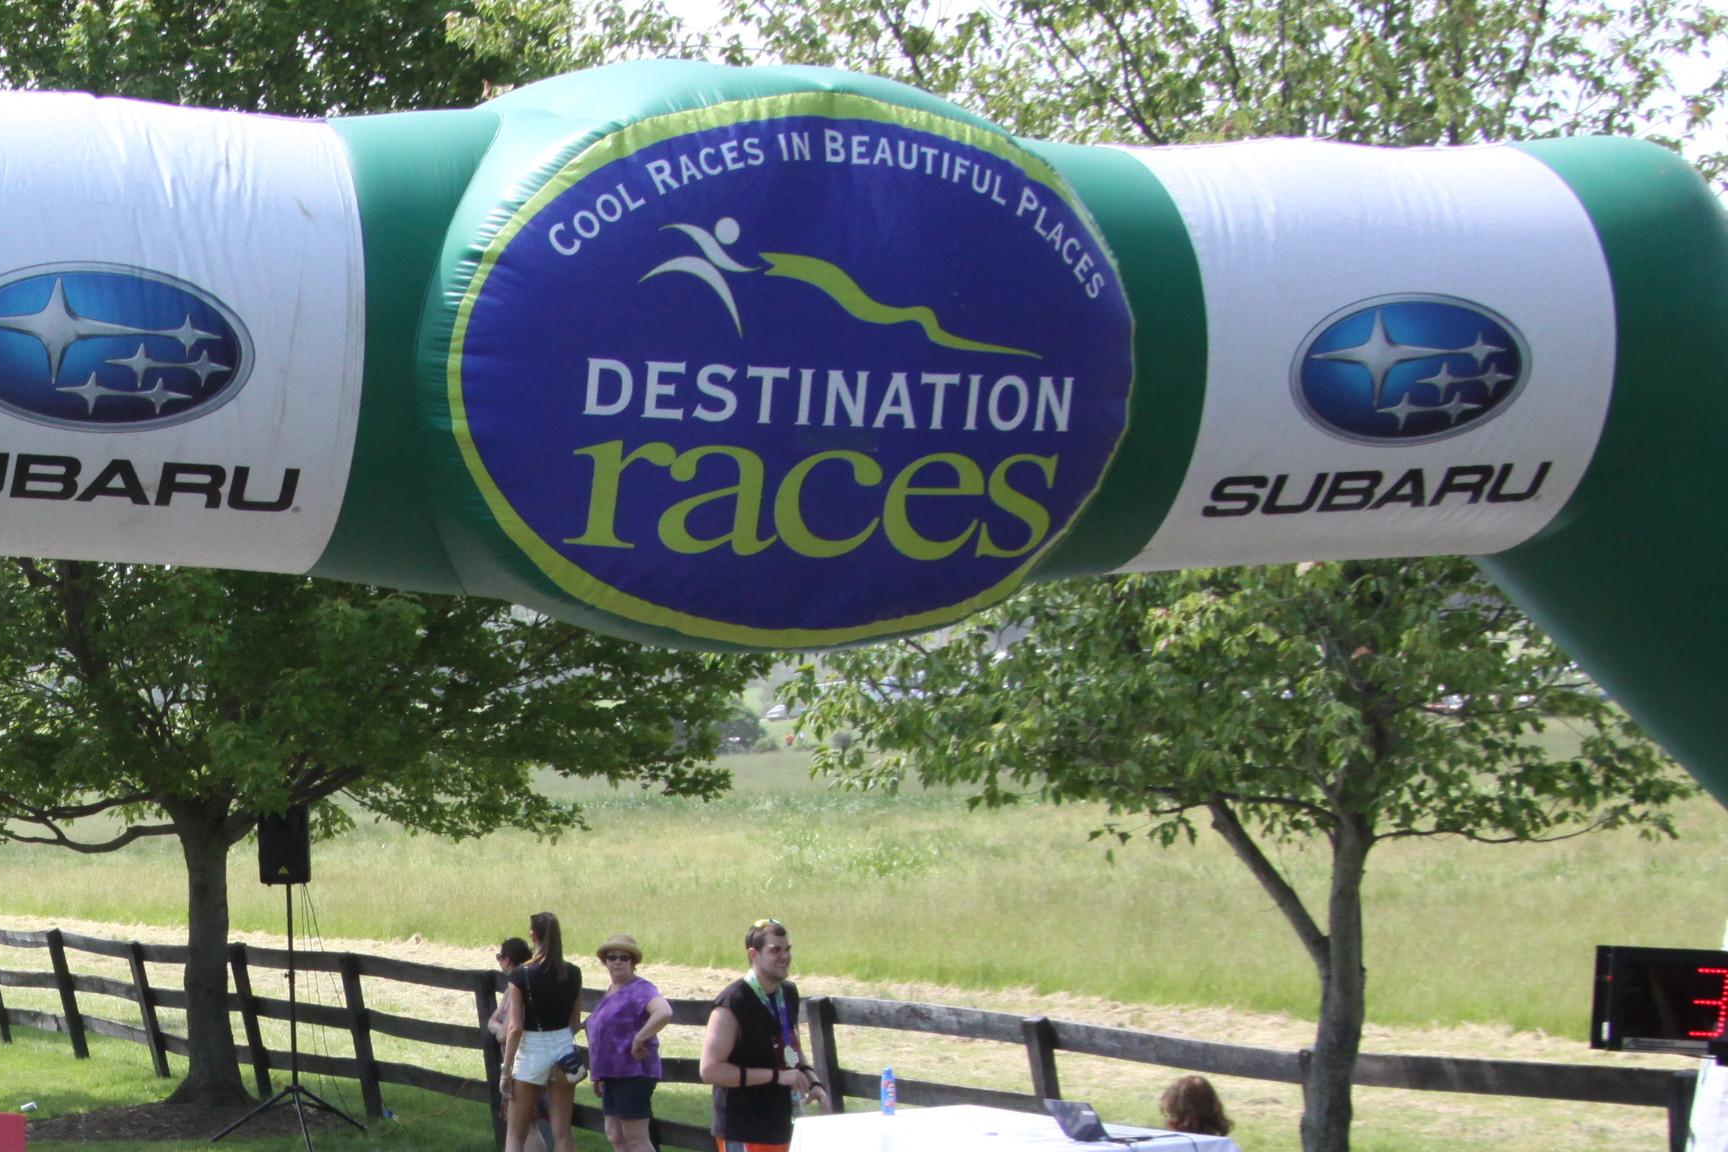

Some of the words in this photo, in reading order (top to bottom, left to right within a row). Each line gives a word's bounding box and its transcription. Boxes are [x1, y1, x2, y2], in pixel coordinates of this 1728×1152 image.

[548, 181, 646, 256] COOL
[647, 135, 765, 195] RACES
[781, 131, 812, 162] IN
[824, 129, 1007, 206] BEAUTIFUL
[1016, 187, 1105, 299] PLACES
[582, 358, 1074, 432] DESTINATION
[562, 439, 1059, 561] races
[1202, 462, 1553, 518] SUBARU
